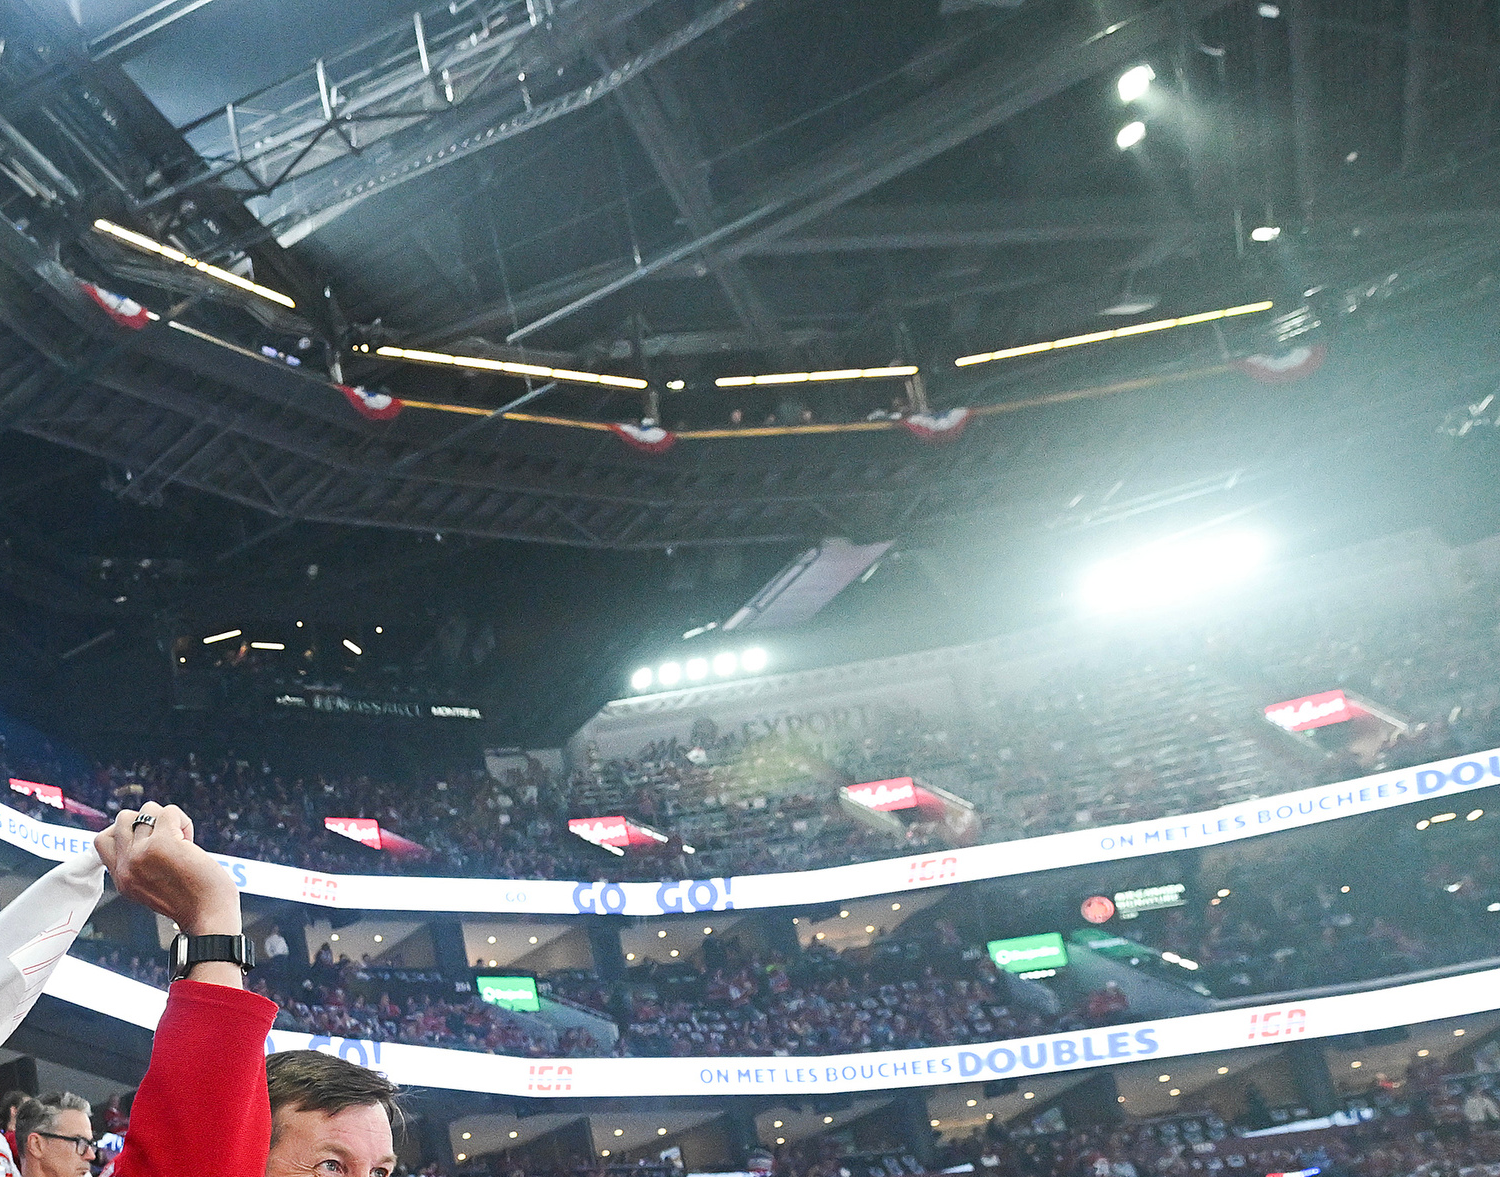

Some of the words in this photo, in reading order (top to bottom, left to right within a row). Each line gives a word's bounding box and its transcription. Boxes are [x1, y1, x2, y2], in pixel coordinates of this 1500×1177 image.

[1100, 836, 1134, 850] ON
[1144, 826, 1192, 844] MET
[1202, 815, 1247, 835] LES
[505, 891, 527, 903] GO
[572, 881, 627, 914] GO
[656, 877, 734, 914] GO!
[1248, 1009, 1307, 1040] IGA
[700, 1068, 729, 1084] ON
[737, 1068, 775, 1084] MET
[784, 1067, 818, 1083] LES
[957, 1028, 1160, 1078] DOUBLES
[528, 1065, 573, 1091] IGA
